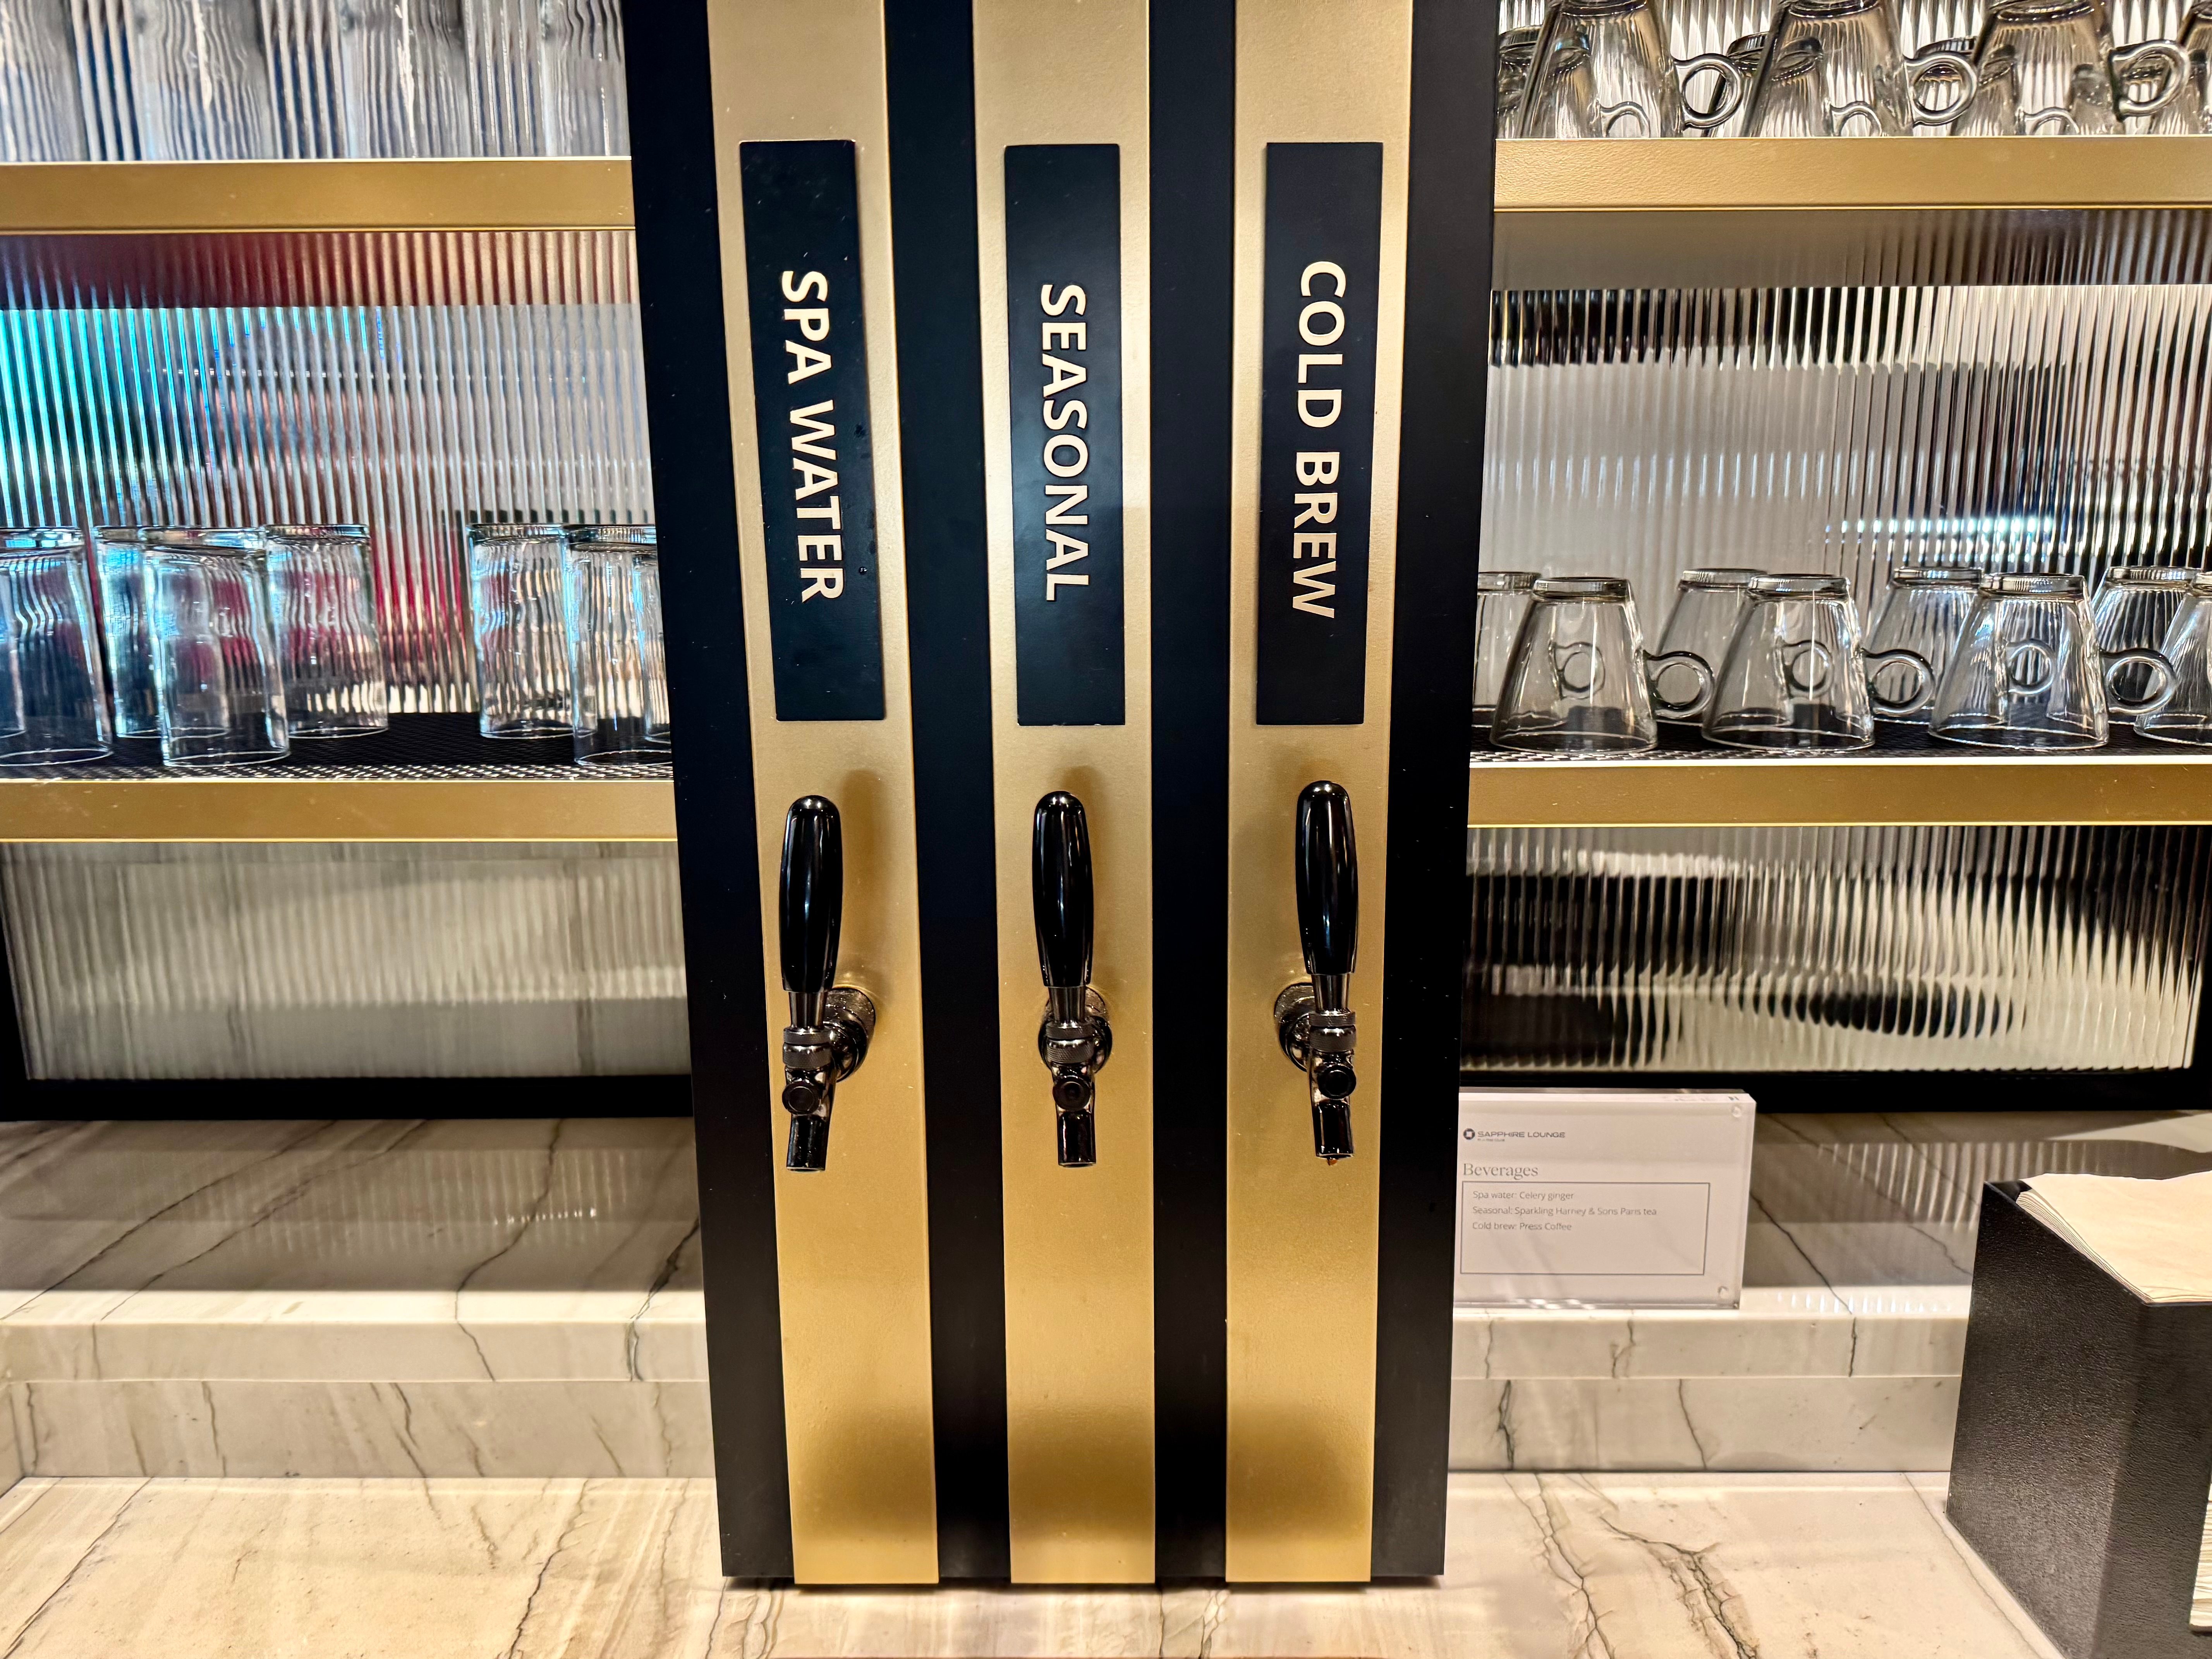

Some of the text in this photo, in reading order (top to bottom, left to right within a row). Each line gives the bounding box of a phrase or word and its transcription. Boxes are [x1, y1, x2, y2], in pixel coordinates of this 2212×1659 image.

[781, 271, 844, 603] SPA WATER
[1041, 284, 1089, 601] SEASONAL
[1292, 261, 1346, 619] COLD BREW
[1463, 1163, 1539, 1180] Beverages
[1473, 1191, 1489, 1200] Spa
[1519, 1191, 1546, 1201] Celery
[1547, 1192, 1574, 1201] ginger
[1473, 1206, 1513, 1214] Seasonal:
[1515, 1207, 1554, 1216] Sparkling
[1556, 1207, 1586, 1217] Harney
[1588, 1207, 1595, 1215] &
[1597, 1207, 1618, 1215] Sons
[1472, 1221, 1491, 1230] Cold
[1519, 1222, 1542, 1230] Press
[1544, 1222, 1572, 1231] Coffee
